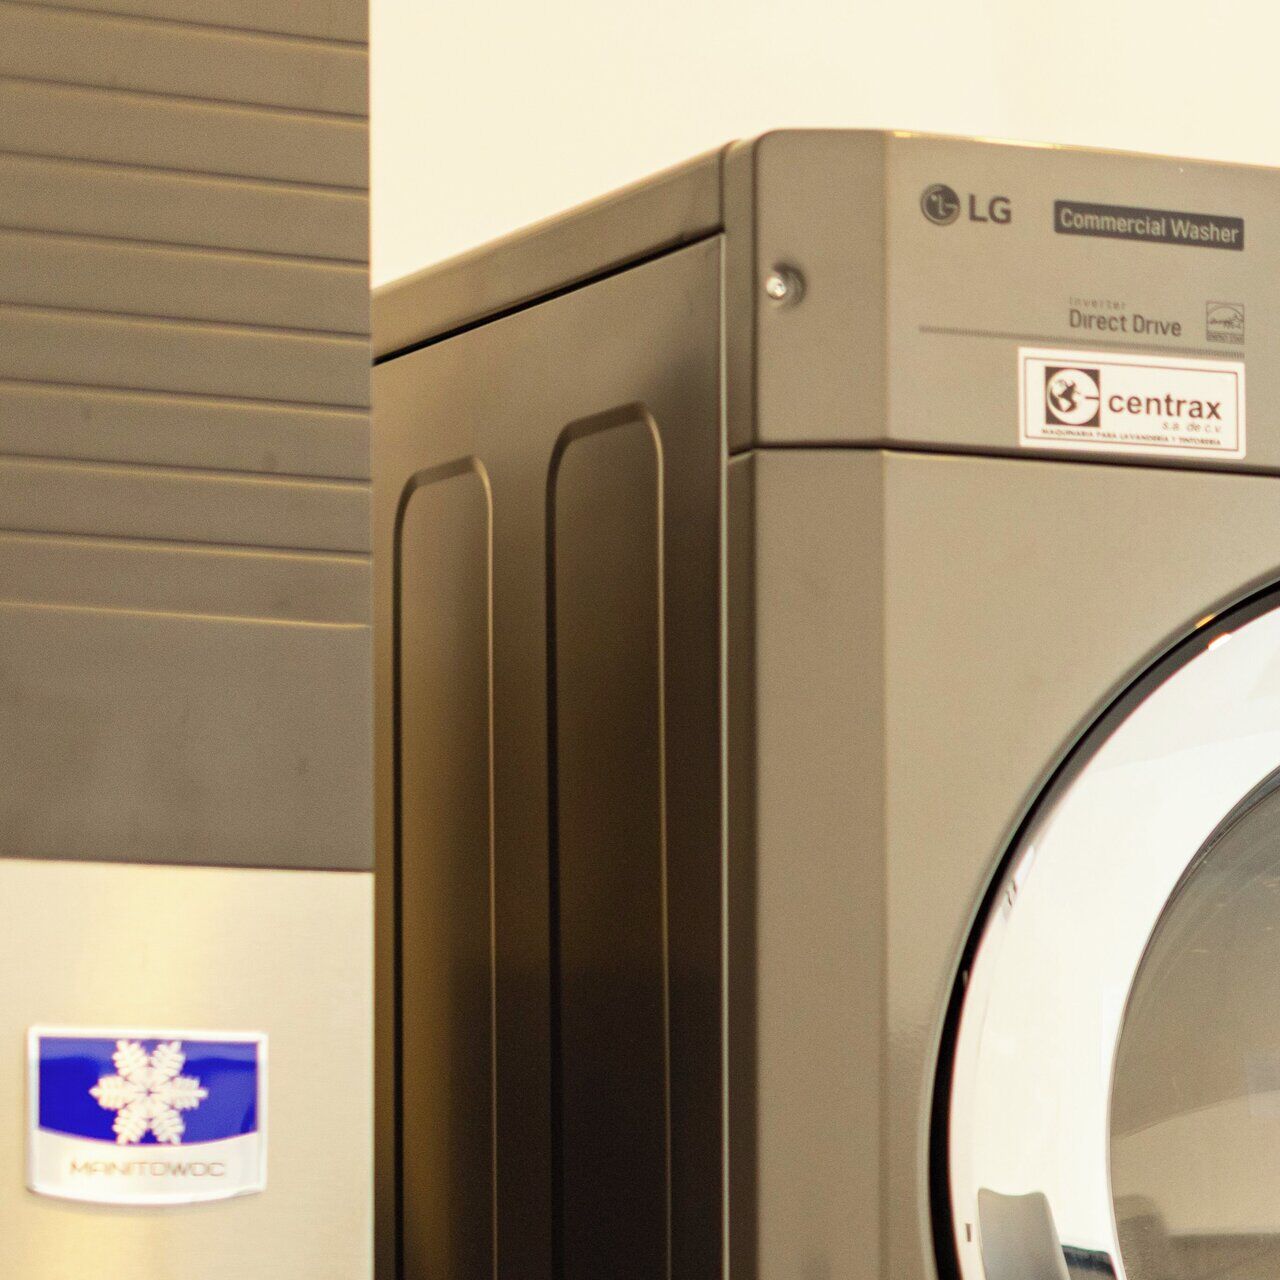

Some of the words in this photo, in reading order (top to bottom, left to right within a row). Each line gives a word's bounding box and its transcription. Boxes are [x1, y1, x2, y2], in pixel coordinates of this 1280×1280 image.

[968, 194, 1012, 224] LG
[1060, 208, 1166, 236] Commercial
[1171, 218, 1240, 244] Washer
[1068, 296, 1126, 310] Inverter
[1068, 308, 1128, 332] Direct
[1132, 314, 1182, 337] Drive
[1108, 392, 1222, 420] centrax
[1042, 429, 1093, 437] MAQUINARIA
[1120, 433, 1168, 441] LAVANDERIA
[69, 1160, 226, 1178] MANITOWOC
